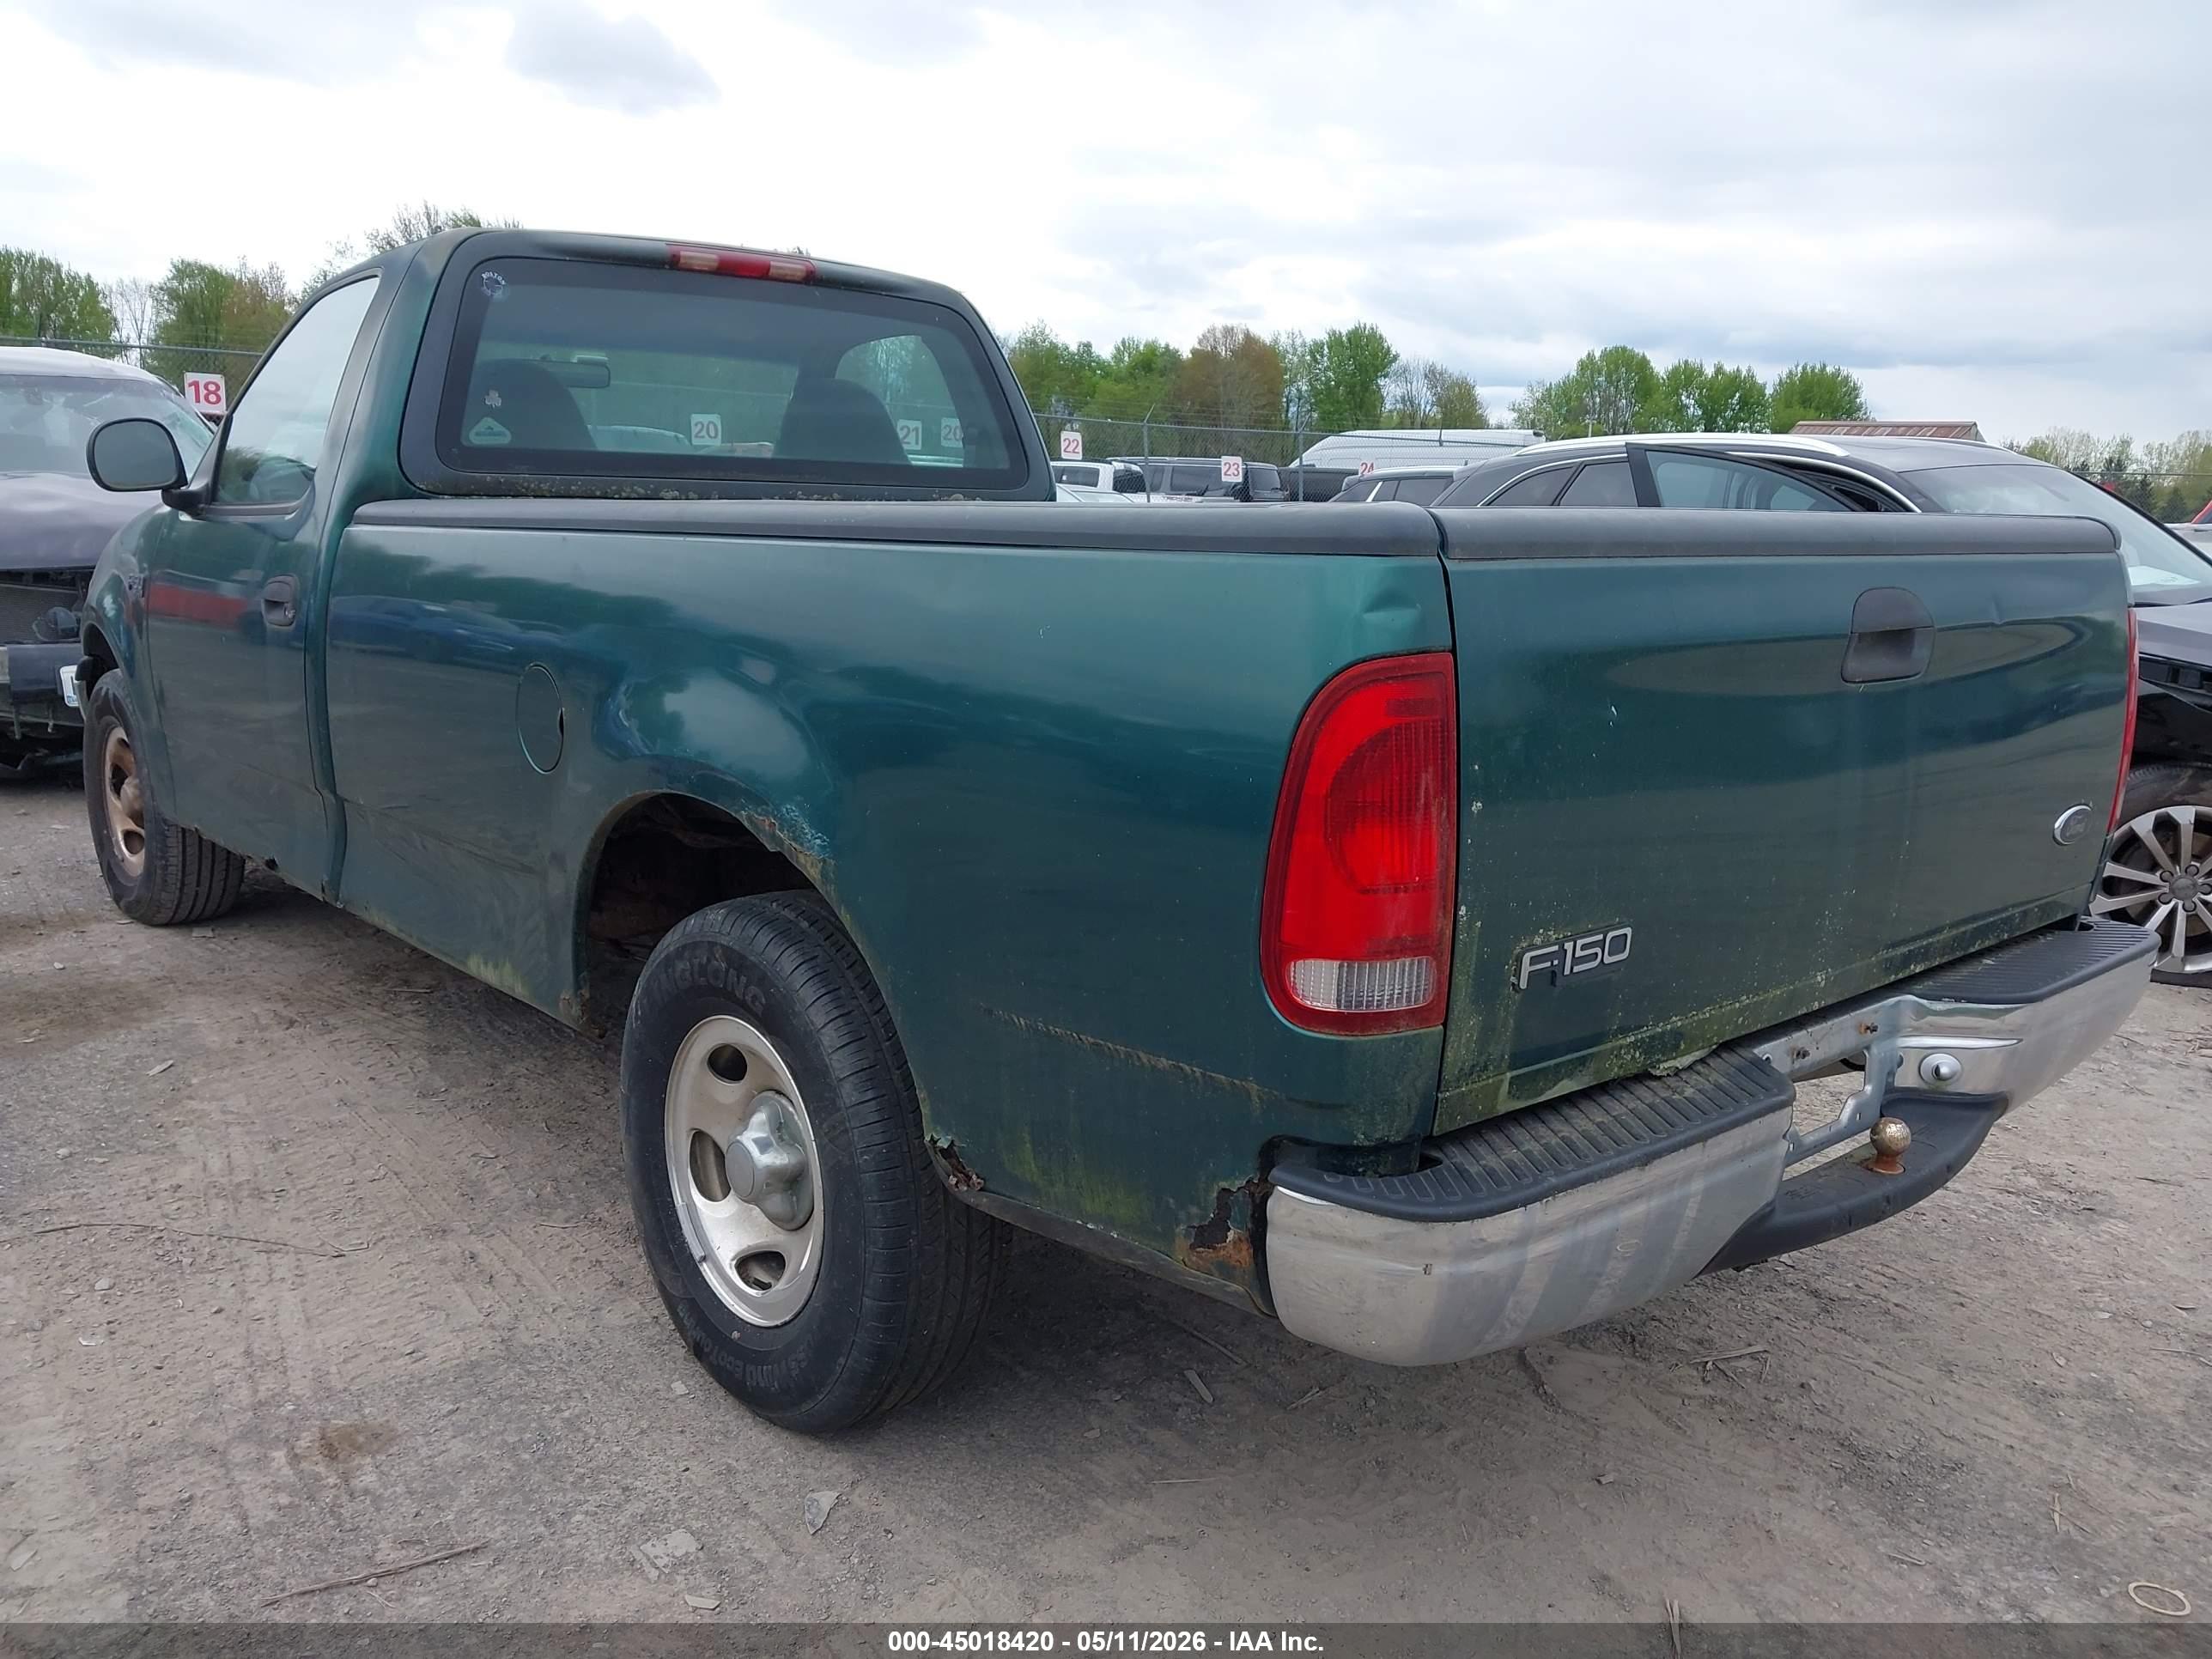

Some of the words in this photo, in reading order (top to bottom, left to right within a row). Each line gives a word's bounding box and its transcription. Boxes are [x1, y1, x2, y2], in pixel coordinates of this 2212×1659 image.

[188, 380, 222, 405] 18
[694, 420, 719, 440] 20
[899, 425, 920, 446] 21
[1063, 438, 1080, 454] 22
[1224, 461, 1240, 477] 23
[1360, 462, 1375, 477] 24
[1519, 927, 1632, 989] F-150
